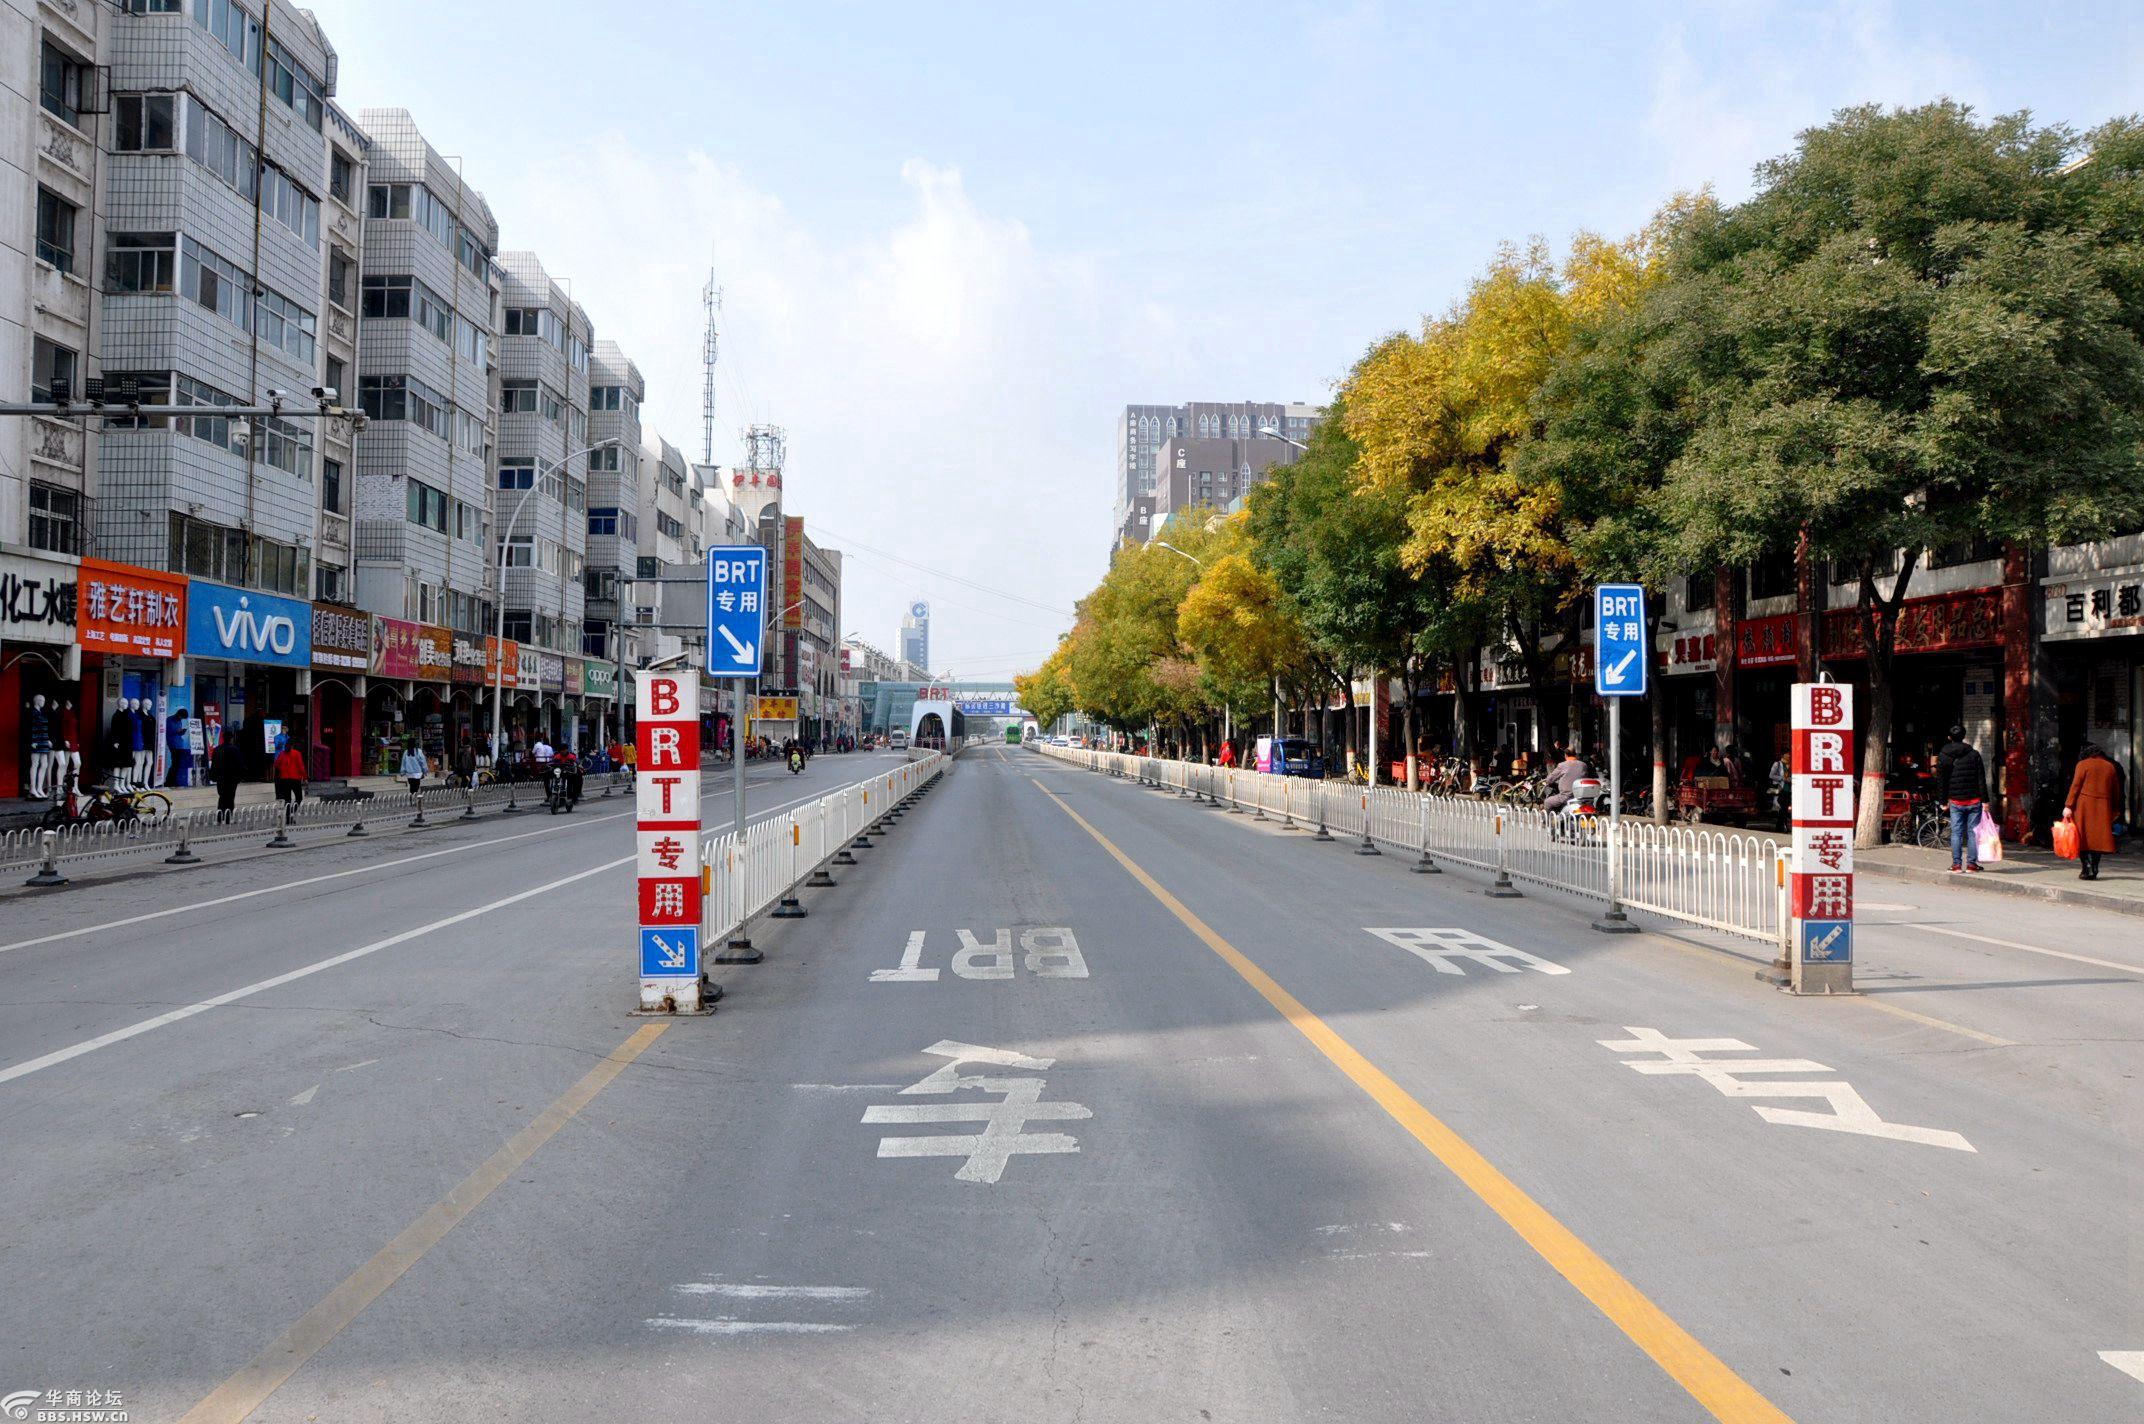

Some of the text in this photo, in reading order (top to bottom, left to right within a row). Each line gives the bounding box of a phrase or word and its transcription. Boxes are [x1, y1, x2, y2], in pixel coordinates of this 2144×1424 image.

[715, 560, 760, 584] BRT
[89, 580, 179, 627] 雅艺轩制衣
[716, 590, 758, 613] 专用
[1602, 596, 1638, 617] BRT
[2065, 585, 2141, 622] 百利都
[1604, 621, 1639, 641] 专用
[919, 687, 949, 701] BRT
[651, 678, 685, 917] BRT 专用
[1808, 687, 1848, 918] BRT 专用
[867, 927, 1090, 982] BRT
